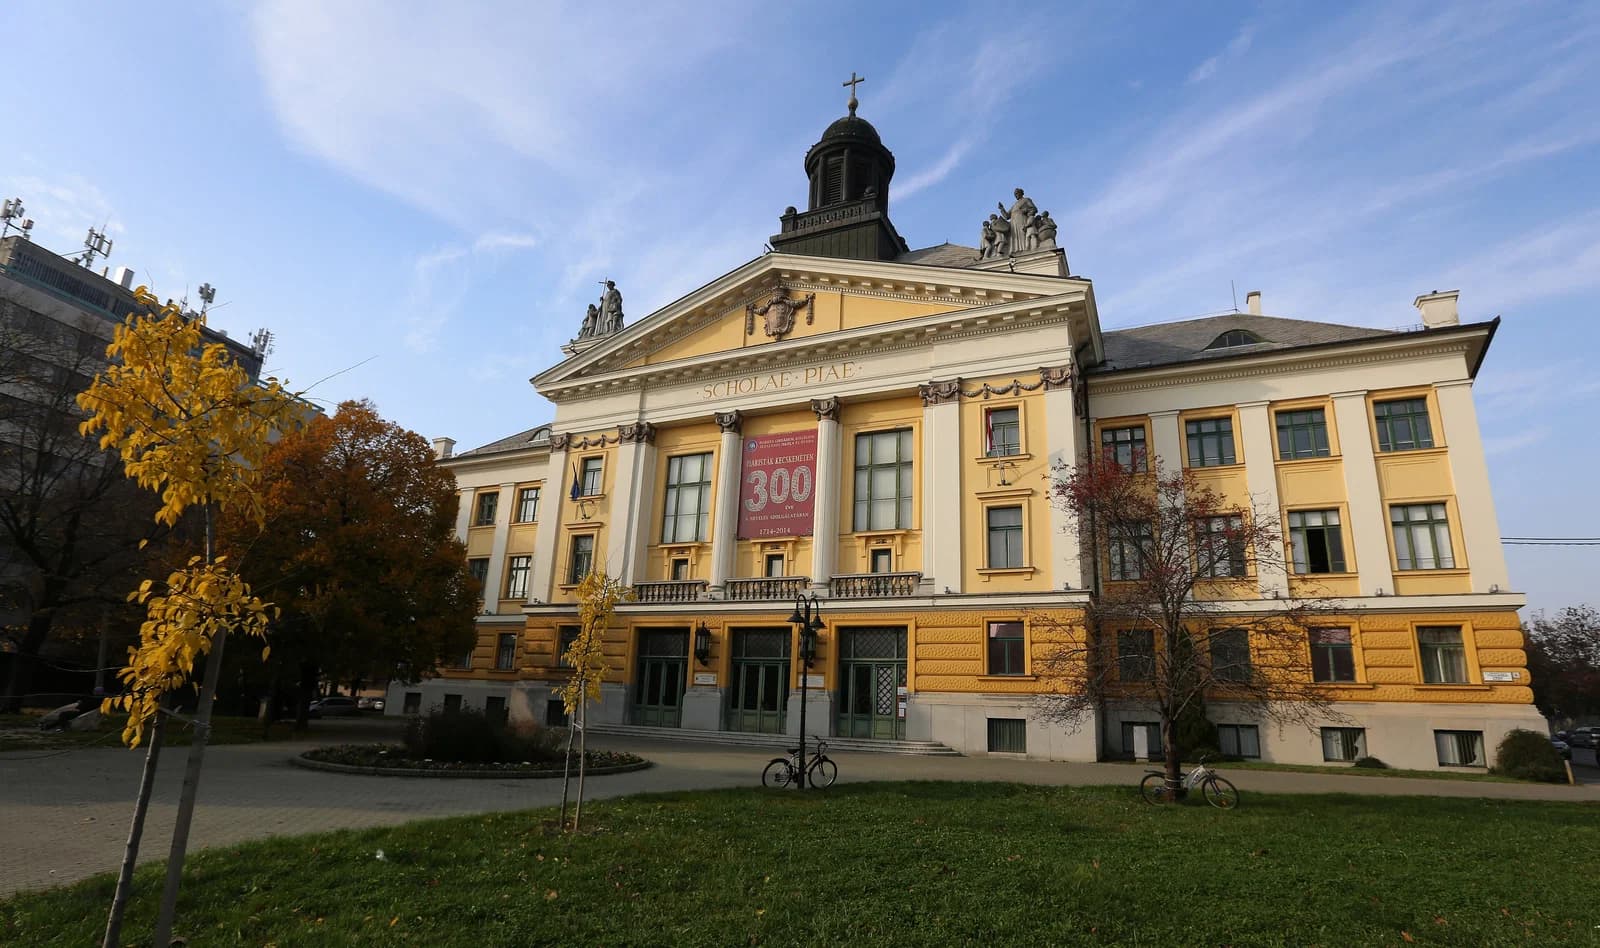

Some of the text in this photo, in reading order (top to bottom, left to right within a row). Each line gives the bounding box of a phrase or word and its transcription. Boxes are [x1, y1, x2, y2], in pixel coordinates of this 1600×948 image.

[703, 361, 856, 399] SCHOLAE PIAE
[744, 465, 812, 512] 300
[759, 527, 791, 535] 1714-2014
